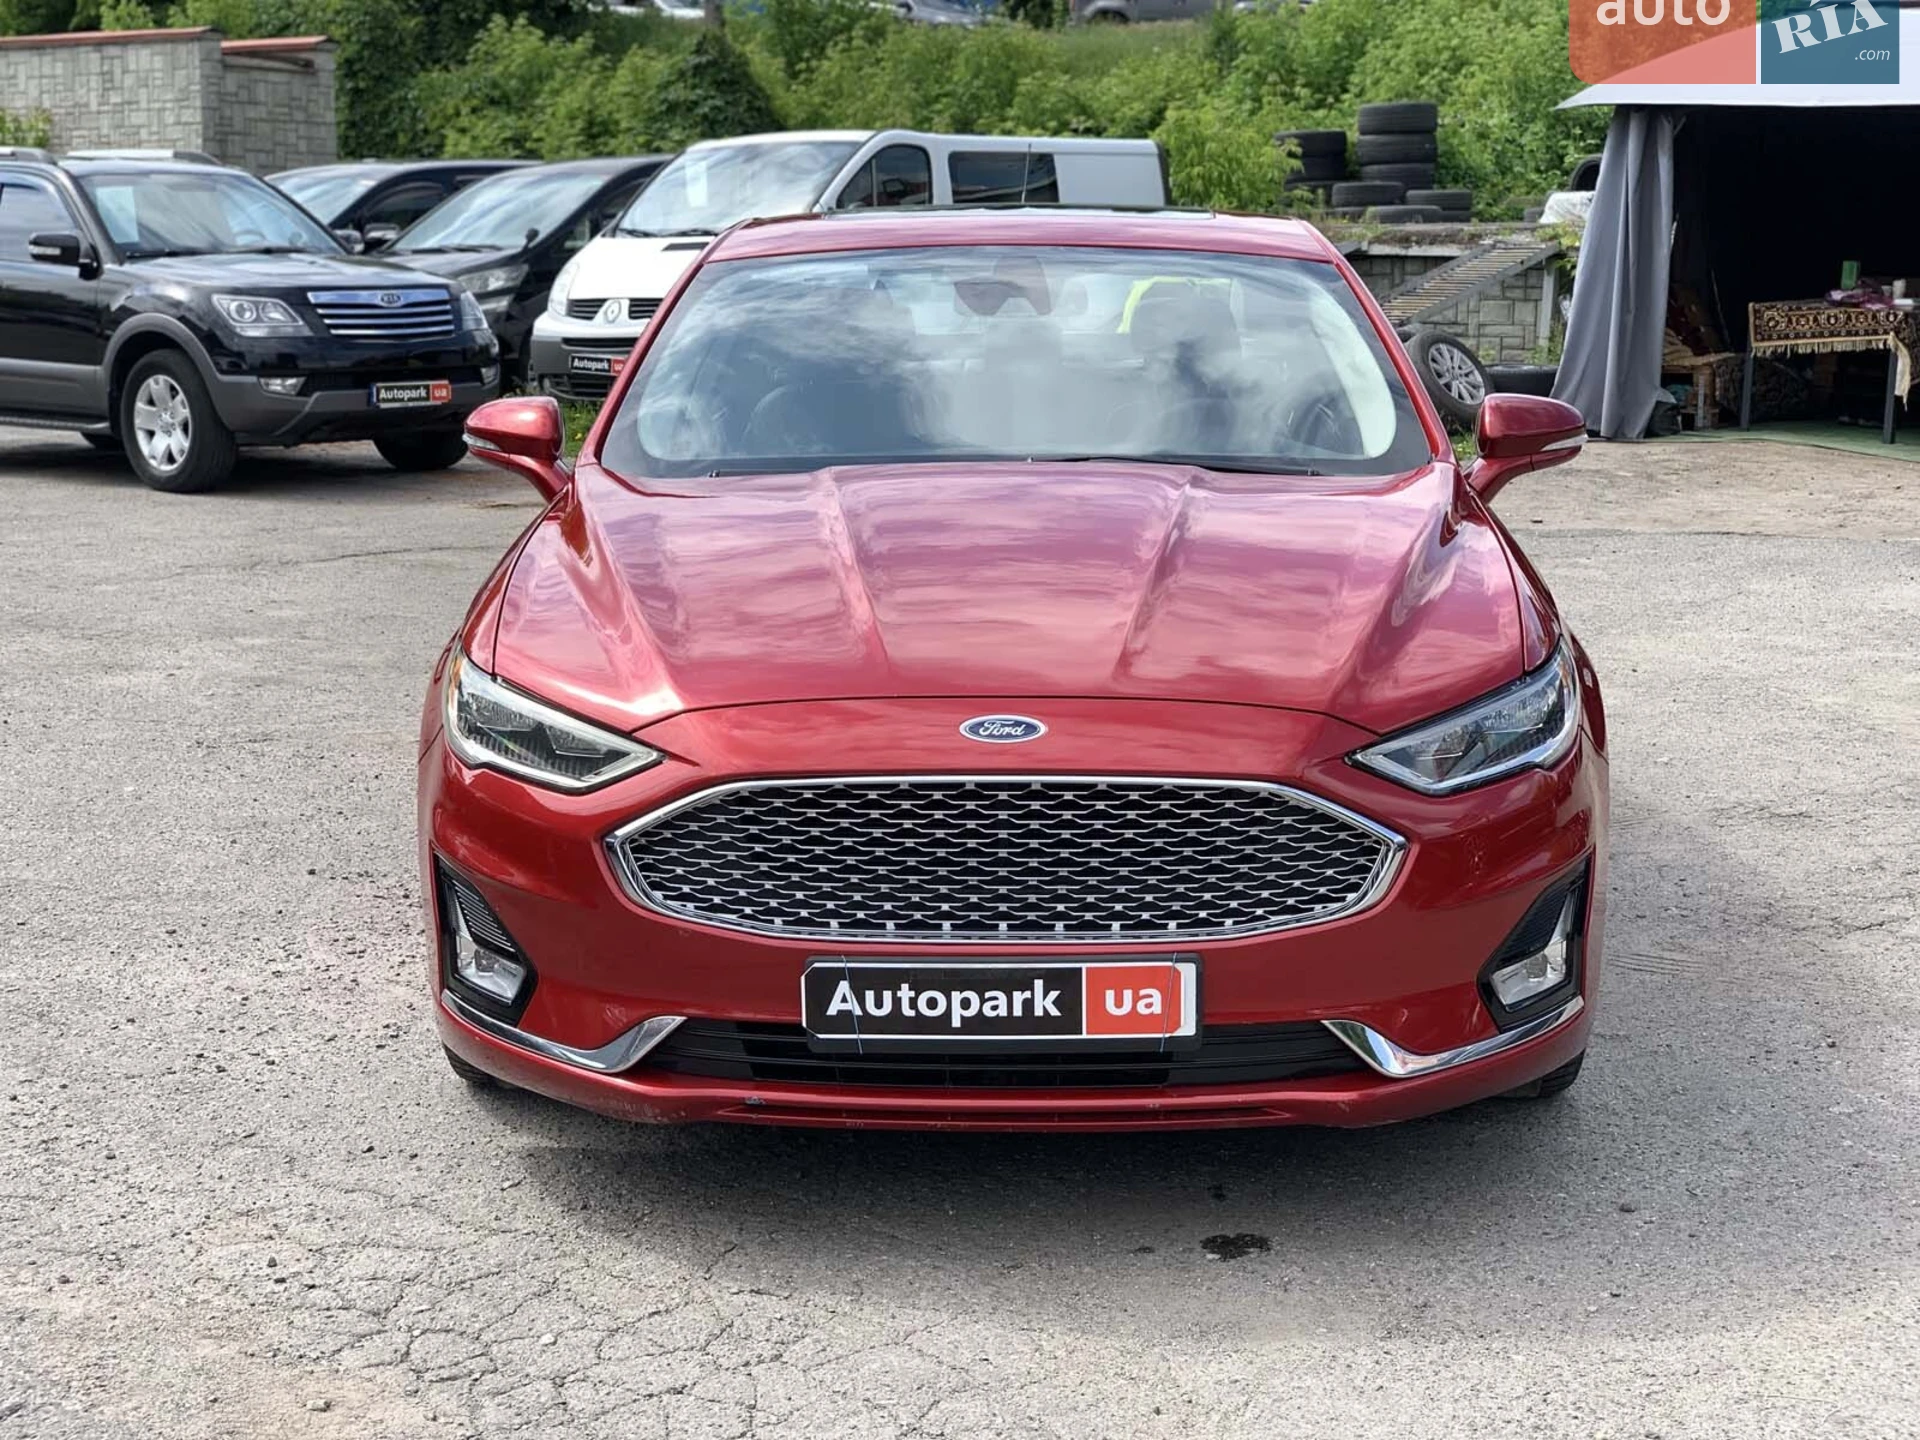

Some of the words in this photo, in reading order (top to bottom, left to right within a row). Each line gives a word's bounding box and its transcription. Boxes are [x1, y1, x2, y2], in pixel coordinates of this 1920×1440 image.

[573, 357, 609, 371] Autopark
[379, 386, 427, 401] Autopark
[434, 388, 447, 397] ua
[979, 720, 1026, 736] Ford
[826, 979, 1062, 1028] Autopark
[1104, 988, 1162, 1015] ua
